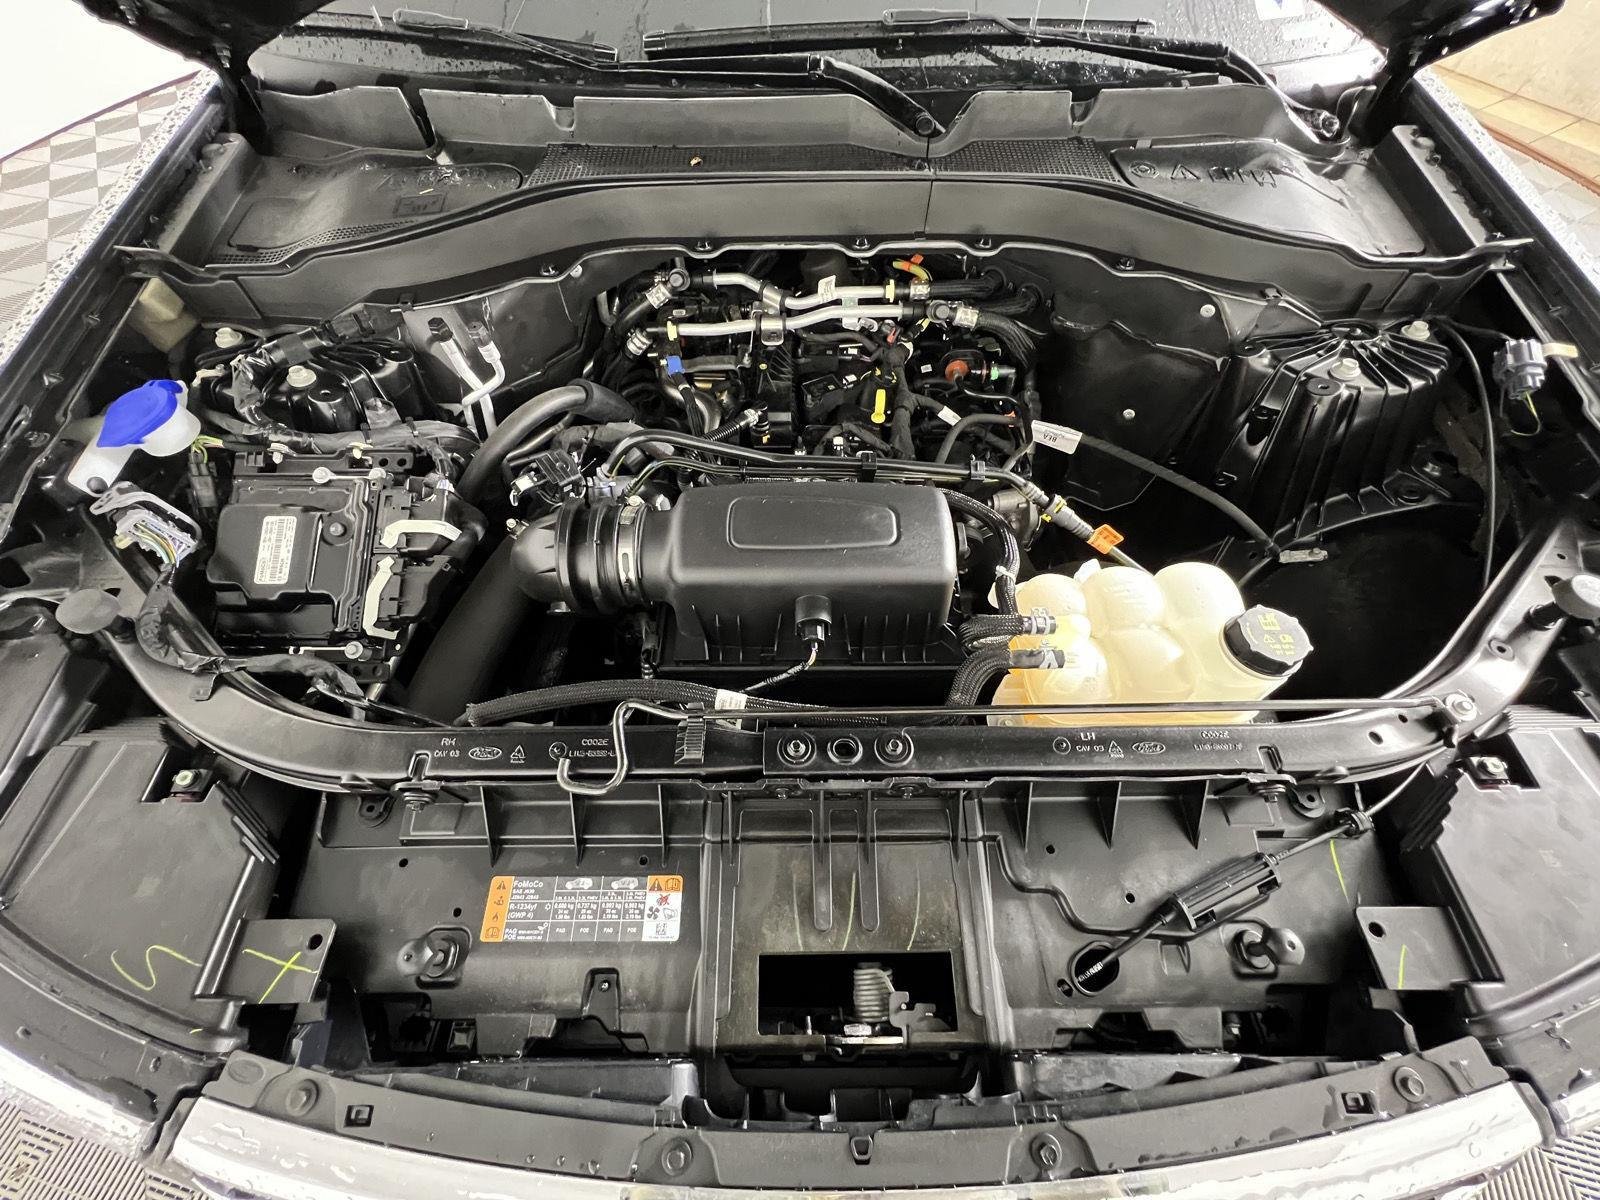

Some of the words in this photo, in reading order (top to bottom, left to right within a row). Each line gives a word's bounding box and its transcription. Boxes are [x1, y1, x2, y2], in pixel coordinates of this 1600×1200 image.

[1080, 731, 1096, 741] LH
[513, 880, 544, 888] FoMoCo
[509, 903, 538, 911] R-1234yf
